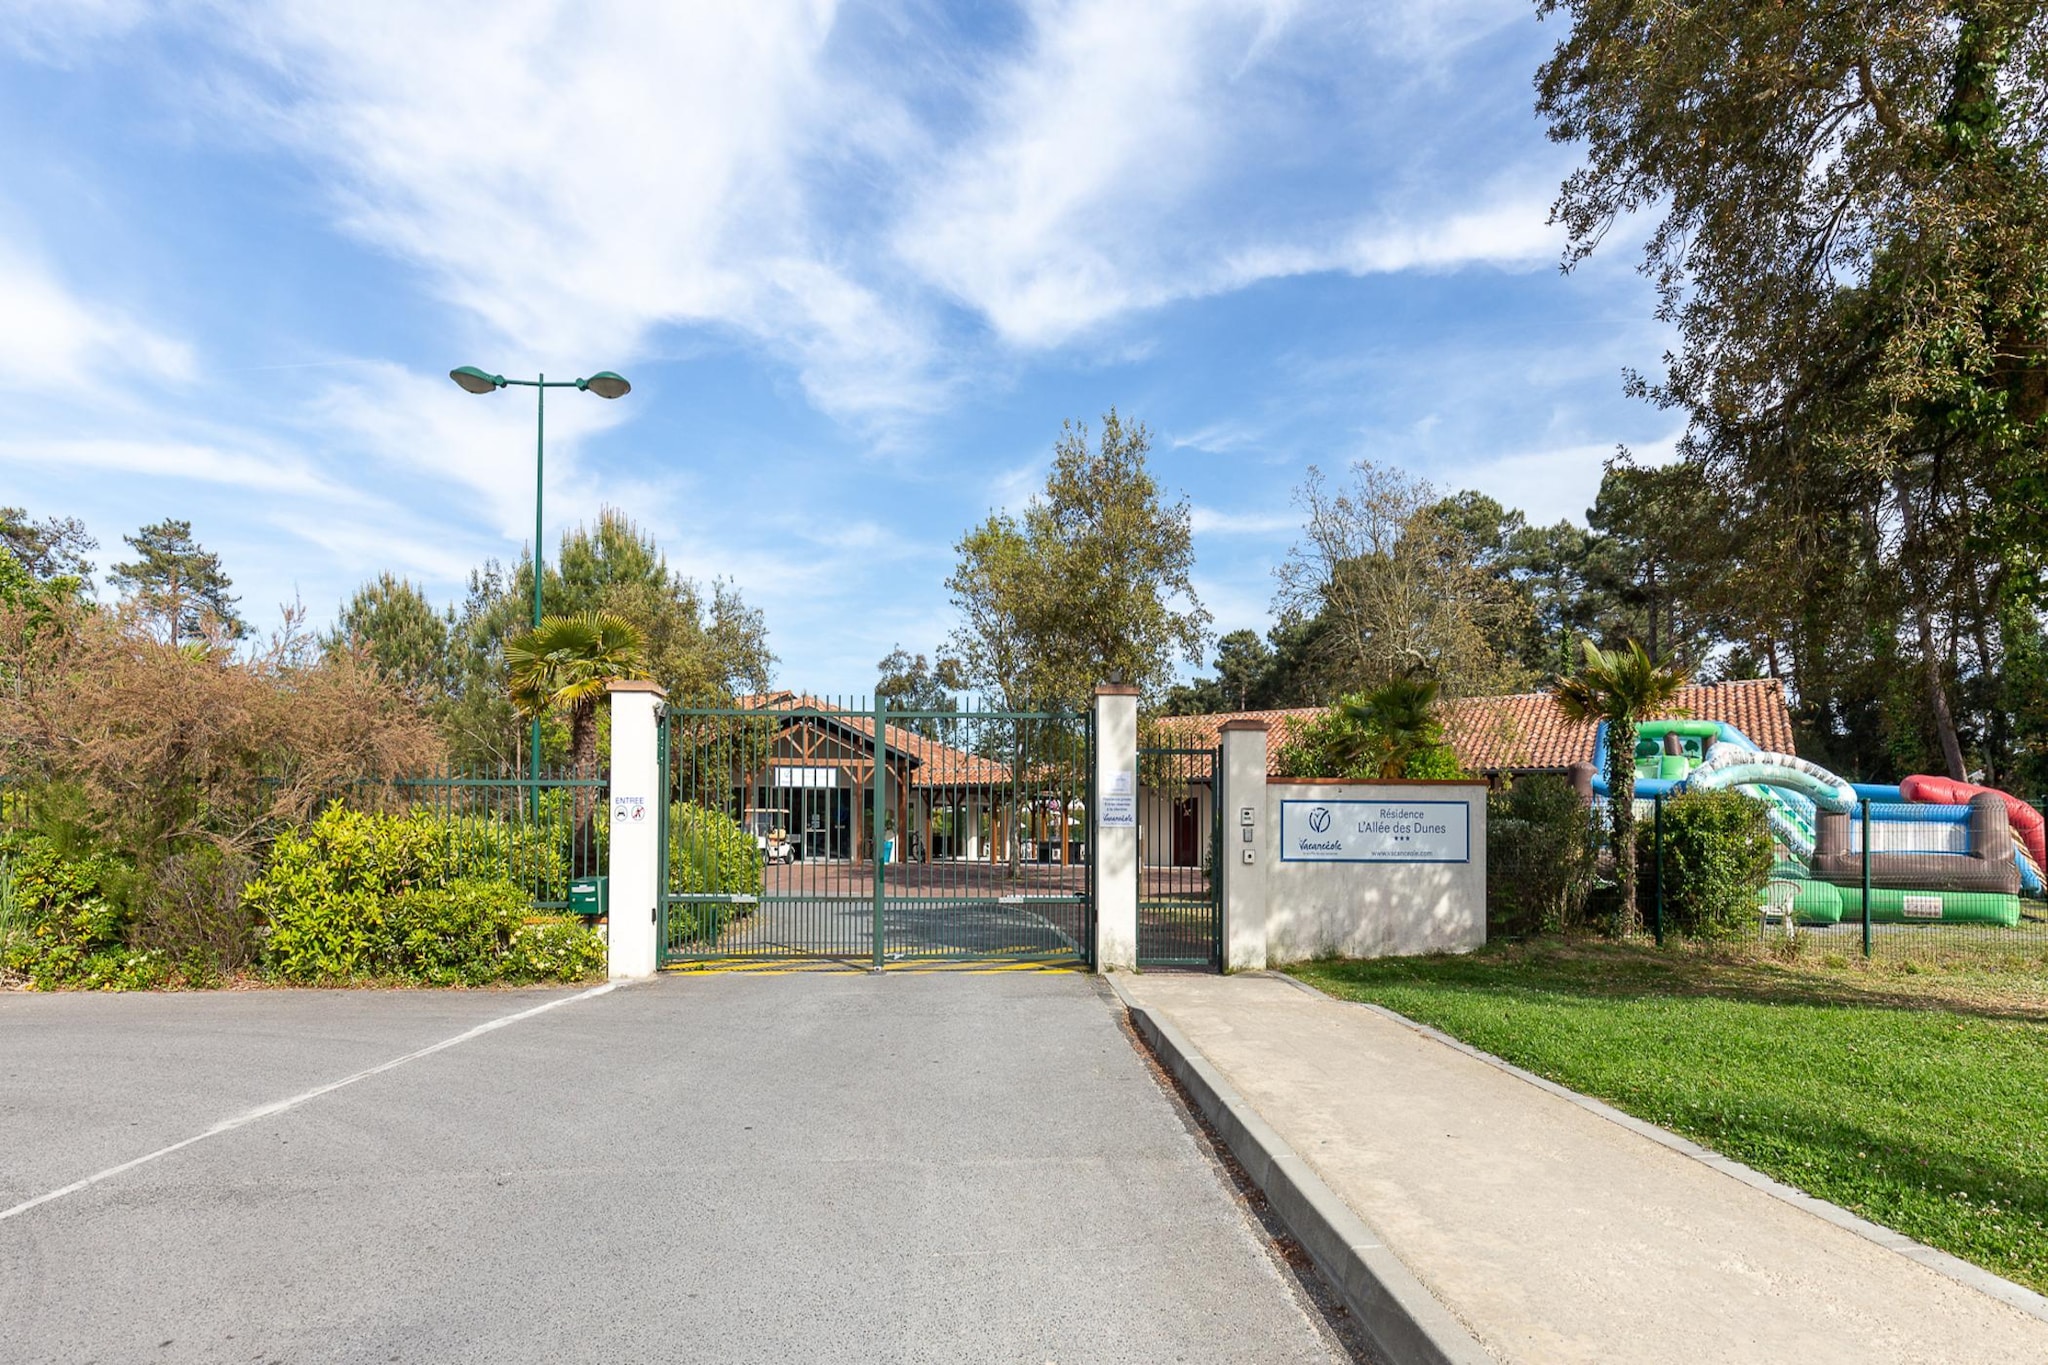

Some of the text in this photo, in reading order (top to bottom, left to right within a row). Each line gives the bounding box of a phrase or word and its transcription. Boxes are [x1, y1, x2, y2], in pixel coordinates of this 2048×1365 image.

[1380, 808, 1424, 819] Résidence
[1358, 821, 1446, 834] L'Allée des Dunes
